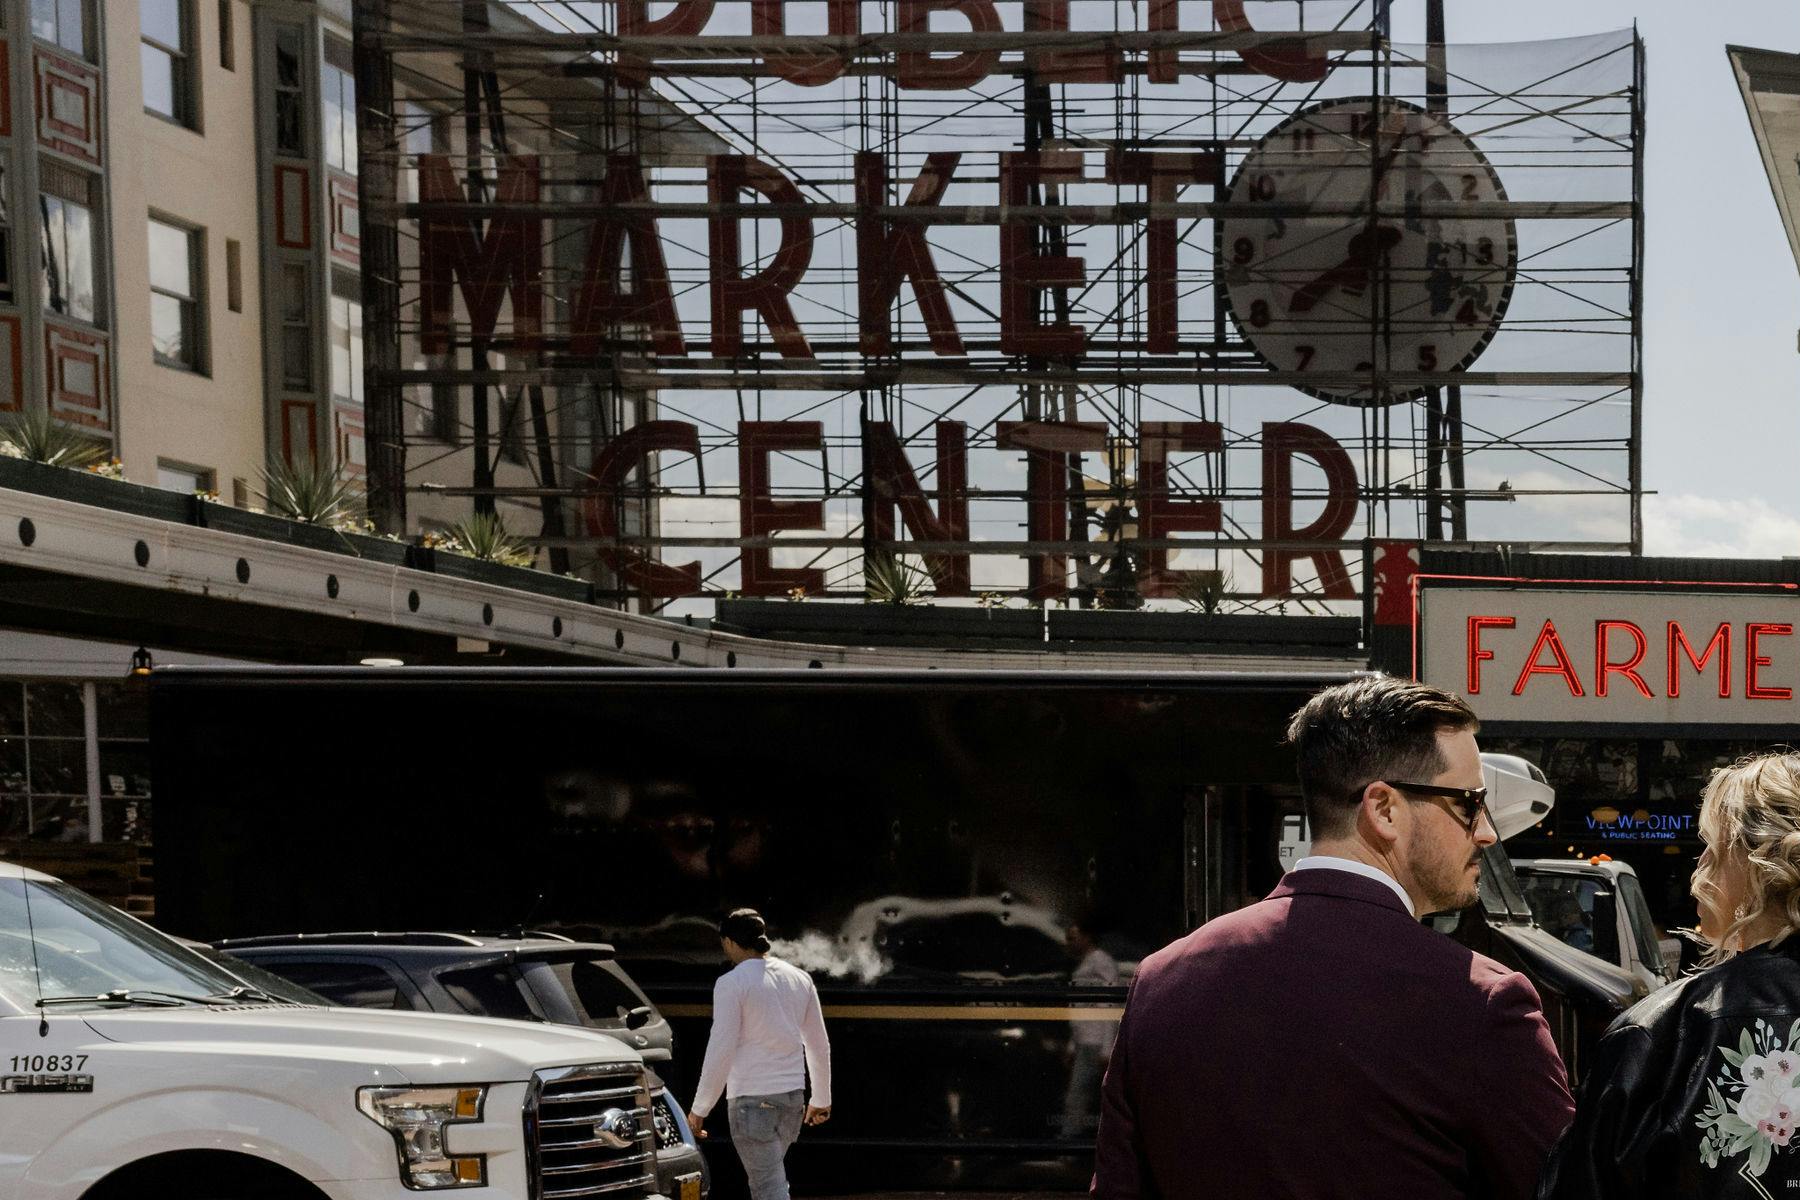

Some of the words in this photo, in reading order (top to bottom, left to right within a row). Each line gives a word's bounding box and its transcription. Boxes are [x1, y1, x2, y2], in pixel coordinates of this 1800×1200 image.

[417, 152, 1226, 358] MARKET
[588, 419, 1361, 600] CENTER
[1609, 831, 1637, 839] PUBLIC
[1641, 831, 1676, 839] SEATING
[10, 1055, 89, 1072] 110837
